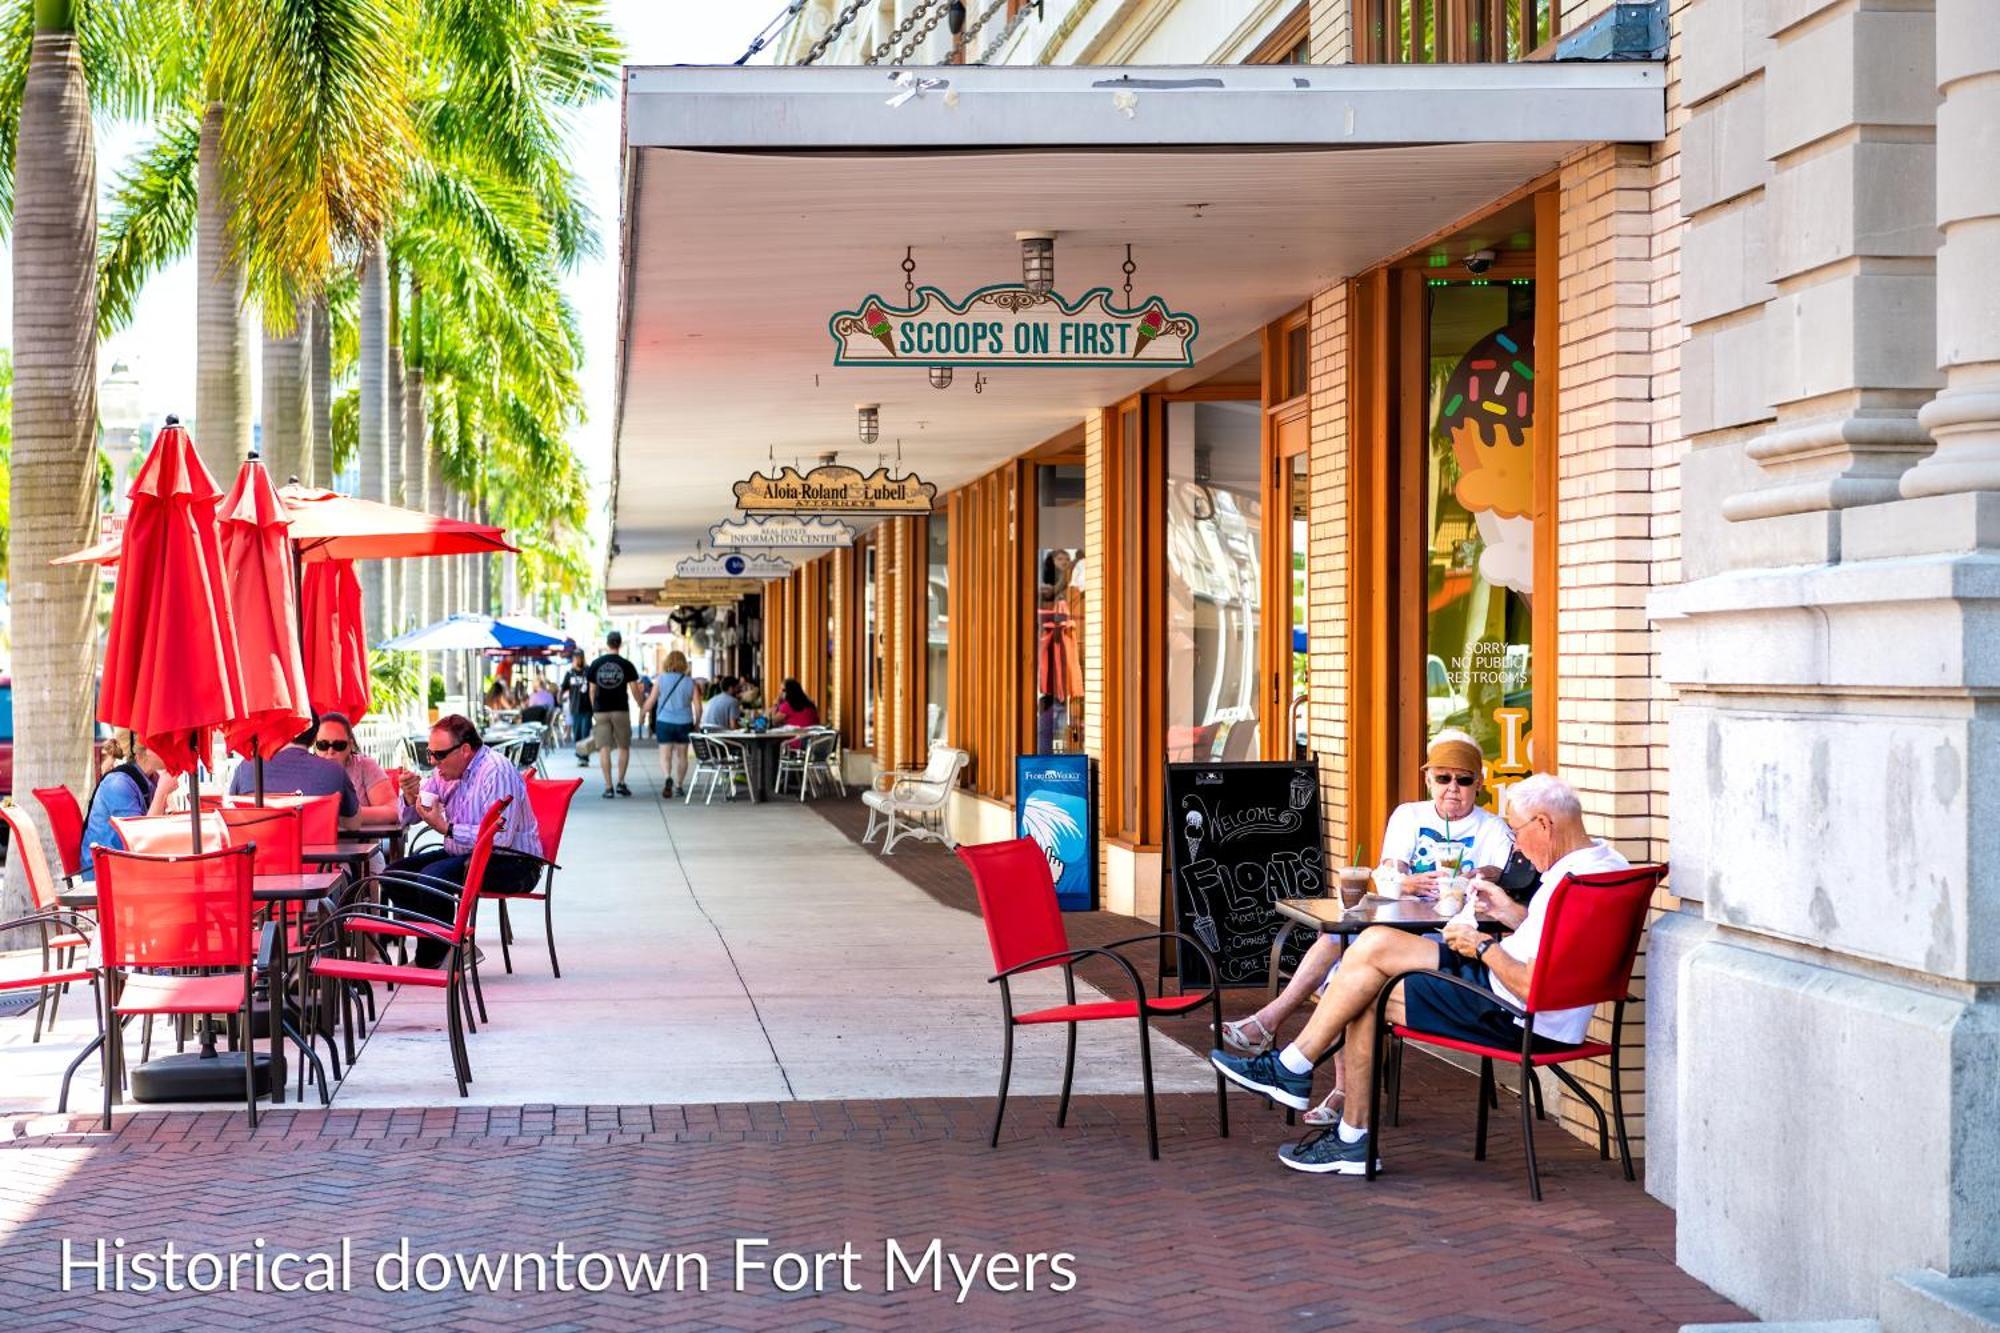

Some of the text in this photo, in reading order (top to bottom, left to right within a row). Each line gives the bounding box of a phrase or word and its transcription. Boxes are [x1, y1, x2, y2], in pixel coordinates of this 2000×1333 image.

[900, 321, 1132, 355] SCOOPS ON FIRST
[731, 534, 837, 544] INFORMATION CENTER
[1465, 641, 1508, 654] SORRY
[1451, 656, 1523, 669] NO PUBLIC
[1447, 671, 1528, 684] RESTROOMS
[1184, 795, 1278, 841] WELCOME
[1180, 846, 1323, 918] FLOATS
